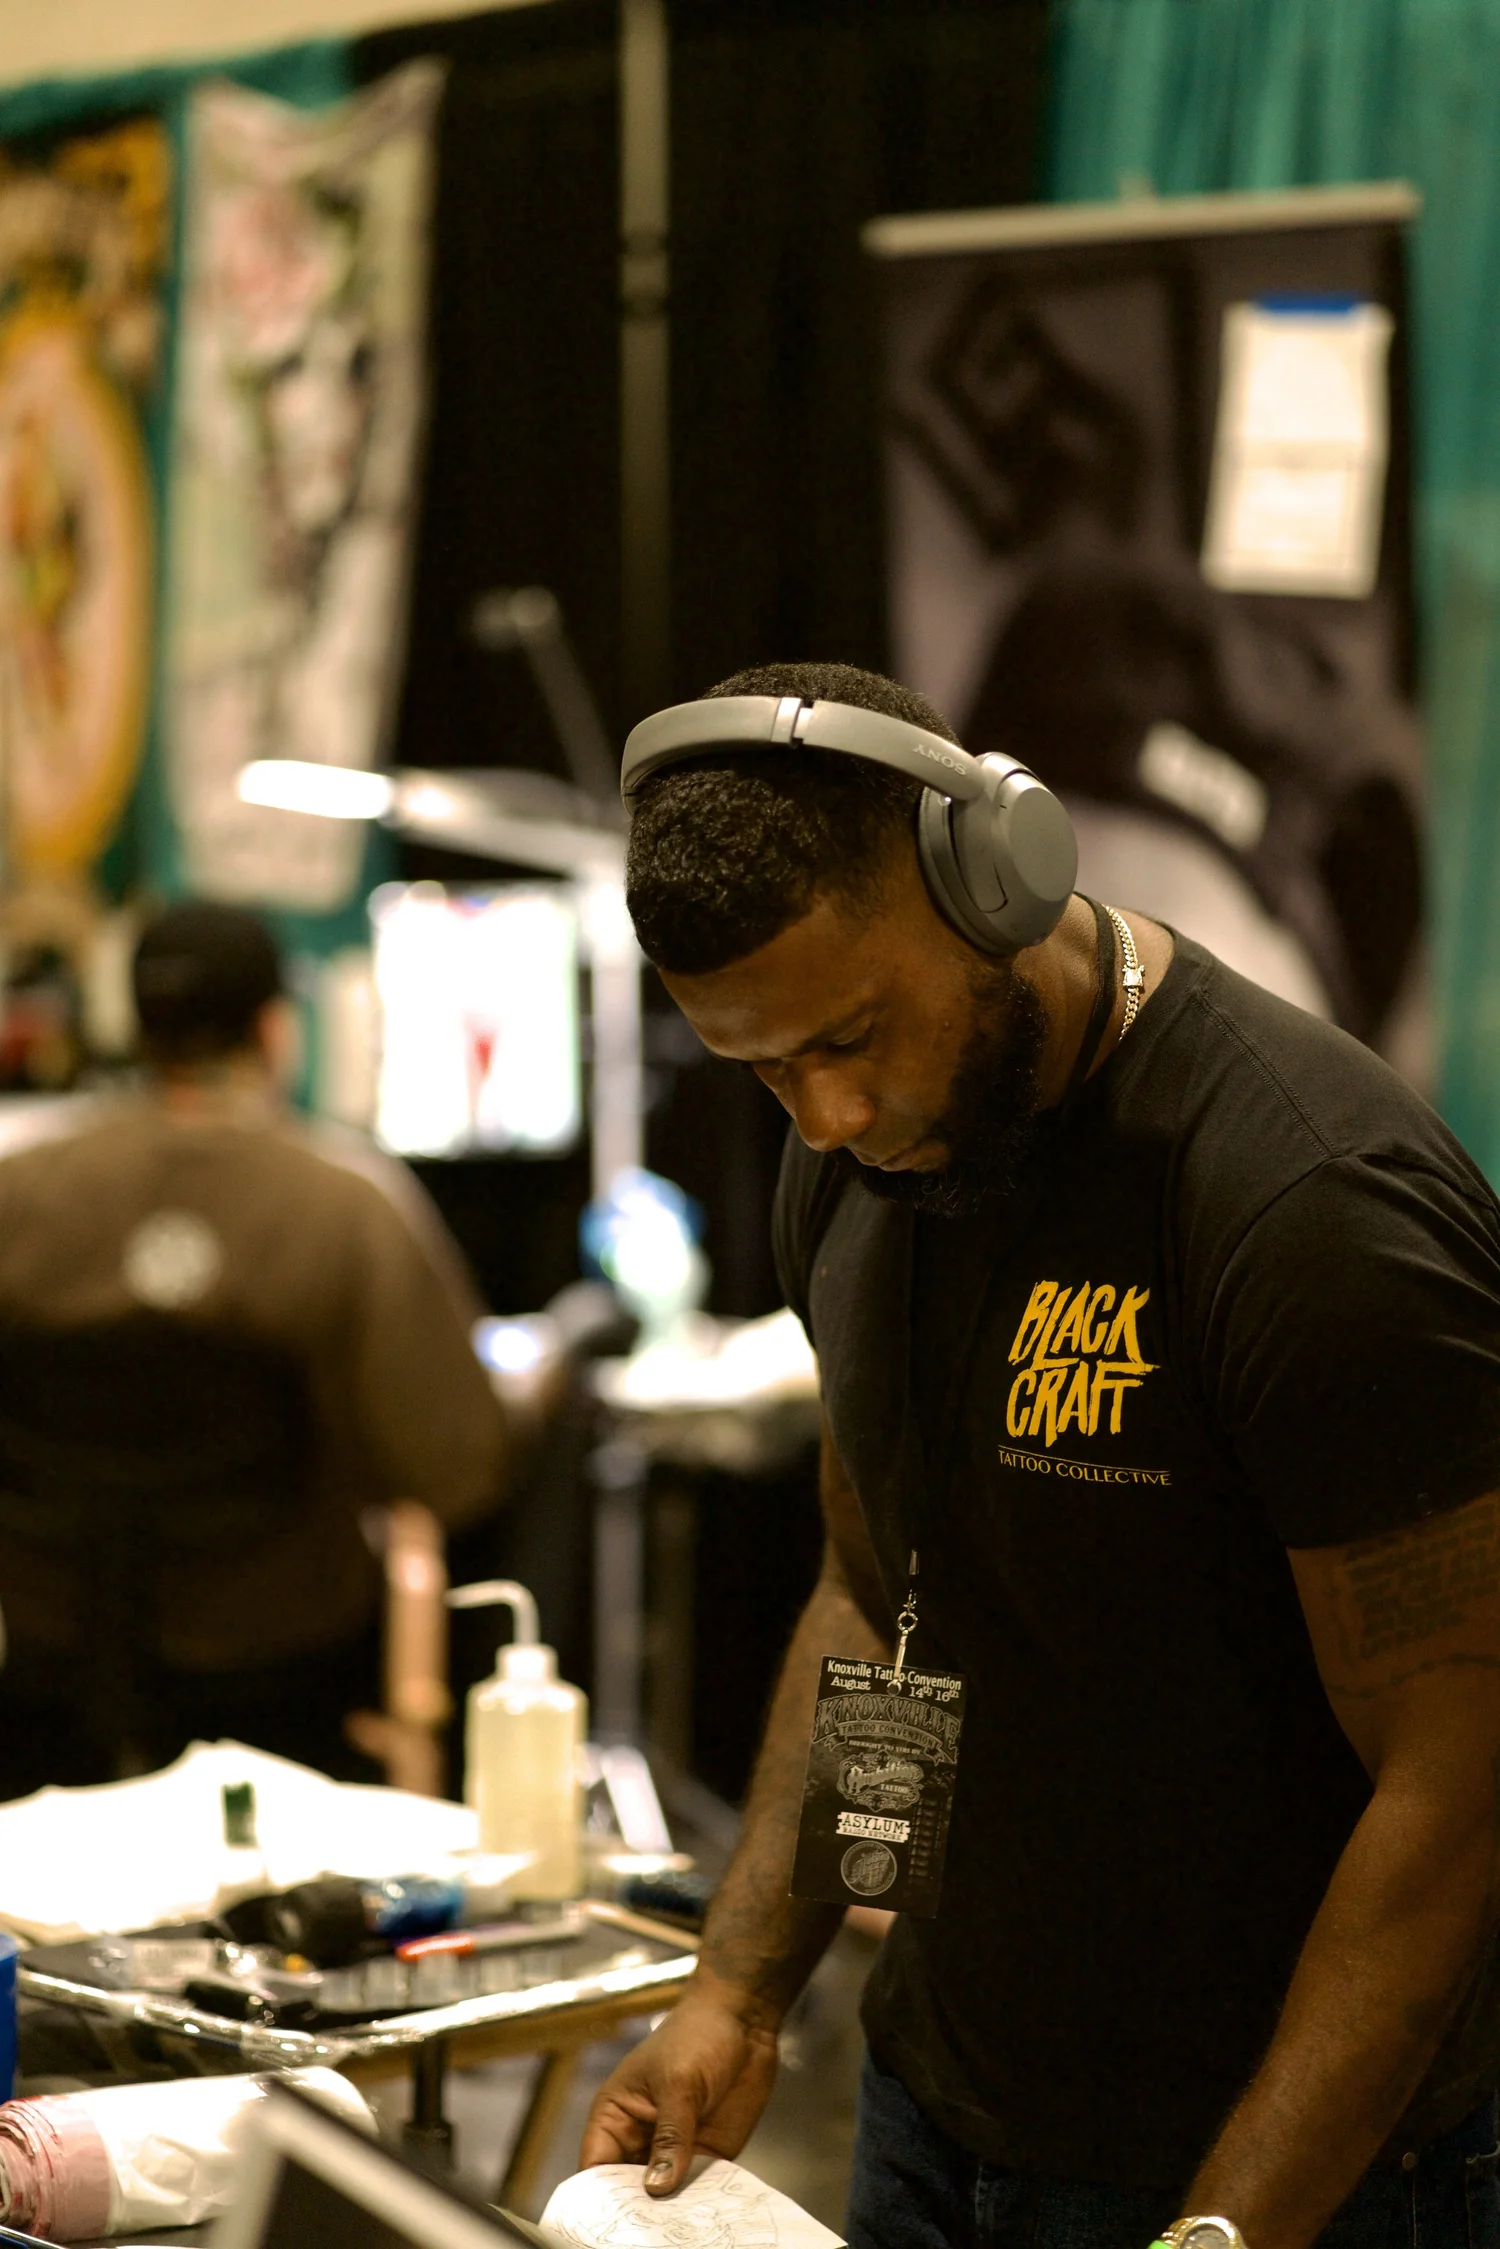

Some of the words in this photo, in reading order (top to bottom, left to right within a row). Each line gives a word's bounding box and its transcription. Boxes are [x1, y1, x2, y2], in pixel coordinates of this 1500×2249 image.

[912, 744, 967, 776] SONY
[1007, 1280, 1151, 1371] BLACK
[1006, 1359, 1152, 1448] CRAFT
[998, 1449, 1051, 1474] TATTOO
[1055, 1462, 1172, 1486] COLLECTIVE
[827, 1660, 872, 1678] Knoxville
[874, 1666, 906, 1682] Tatto
[907, 1671, 962, 1690] Convention
[830, 1676, 871, 1691] August
[935, 1690, 960, 1703] 16th
[813, 1693, 962, 1764] KNOXVILLE
[841, 1724, 876, 1734] TATTOO
[879, 1724, 937, 1748] CONVENTION
[880, 1784, 910, 1794] TATTOO
[842, 1814, 905, 1834] ASYLUM
[842, 1826, 867, 1836] RADIO
[867, 1830, 902, 1841] NETWORK
